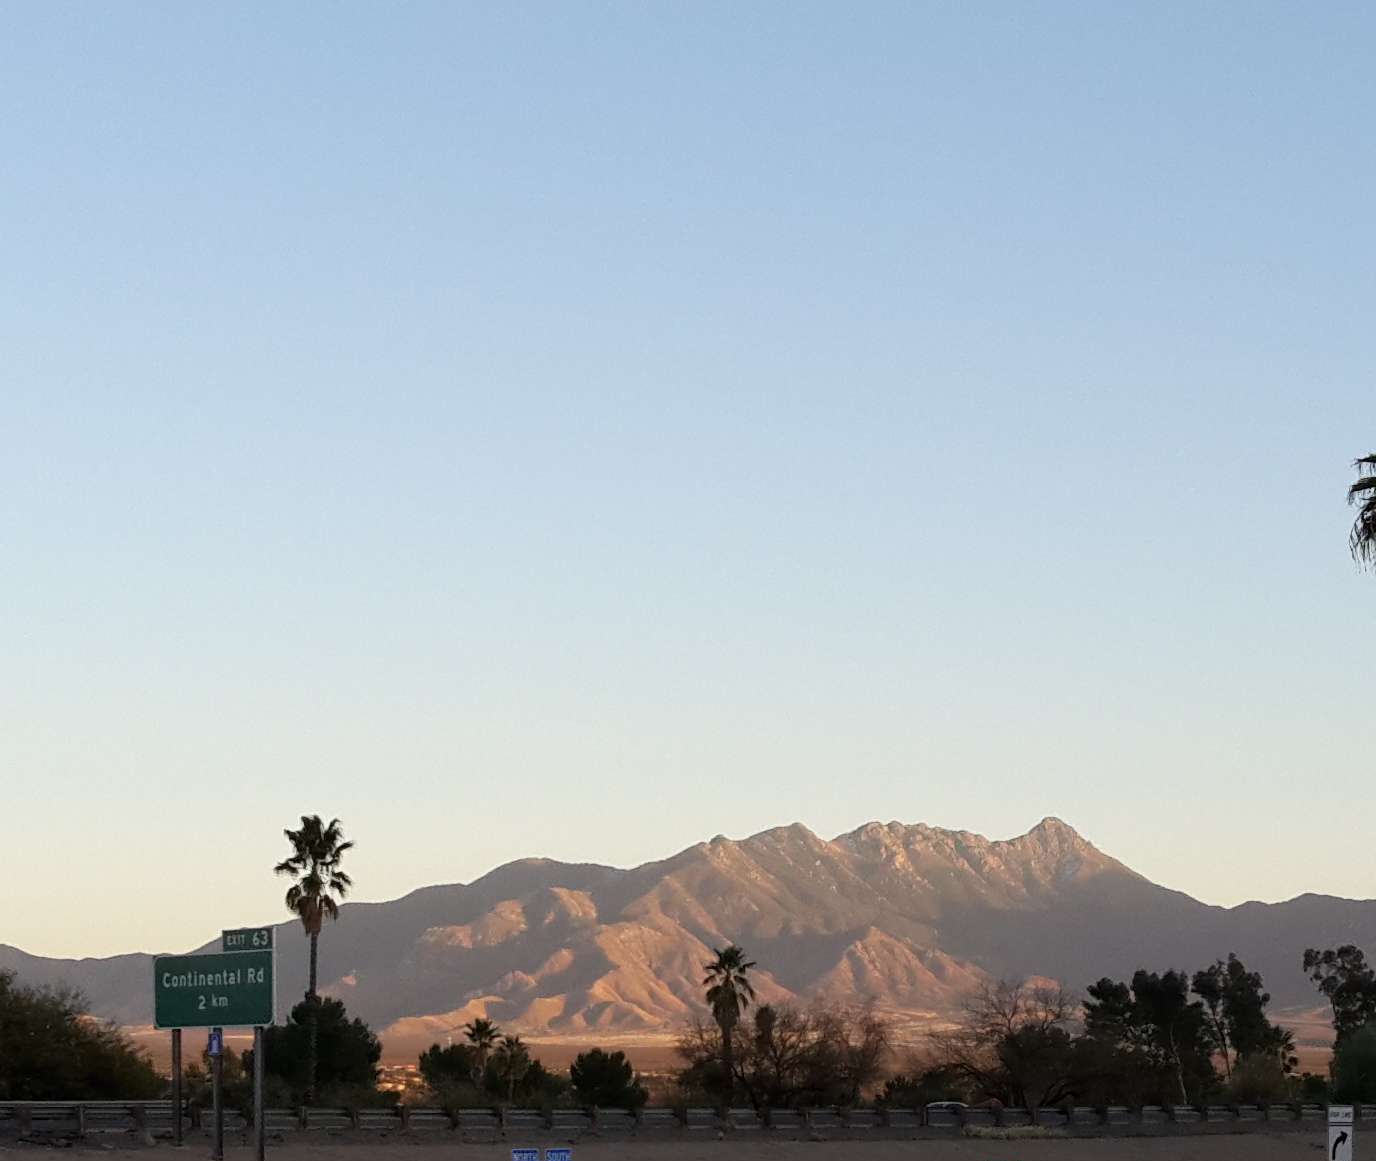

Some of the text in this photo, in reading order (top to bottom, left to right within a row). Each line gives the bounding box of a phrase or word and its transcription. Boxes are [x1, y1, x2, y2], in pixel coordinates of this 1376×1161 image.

[227, 930, 269, 946] EXIT 63
[162, 967, 264, 988] Continental Rd
[198, 993, 229, 1010] 2 km
